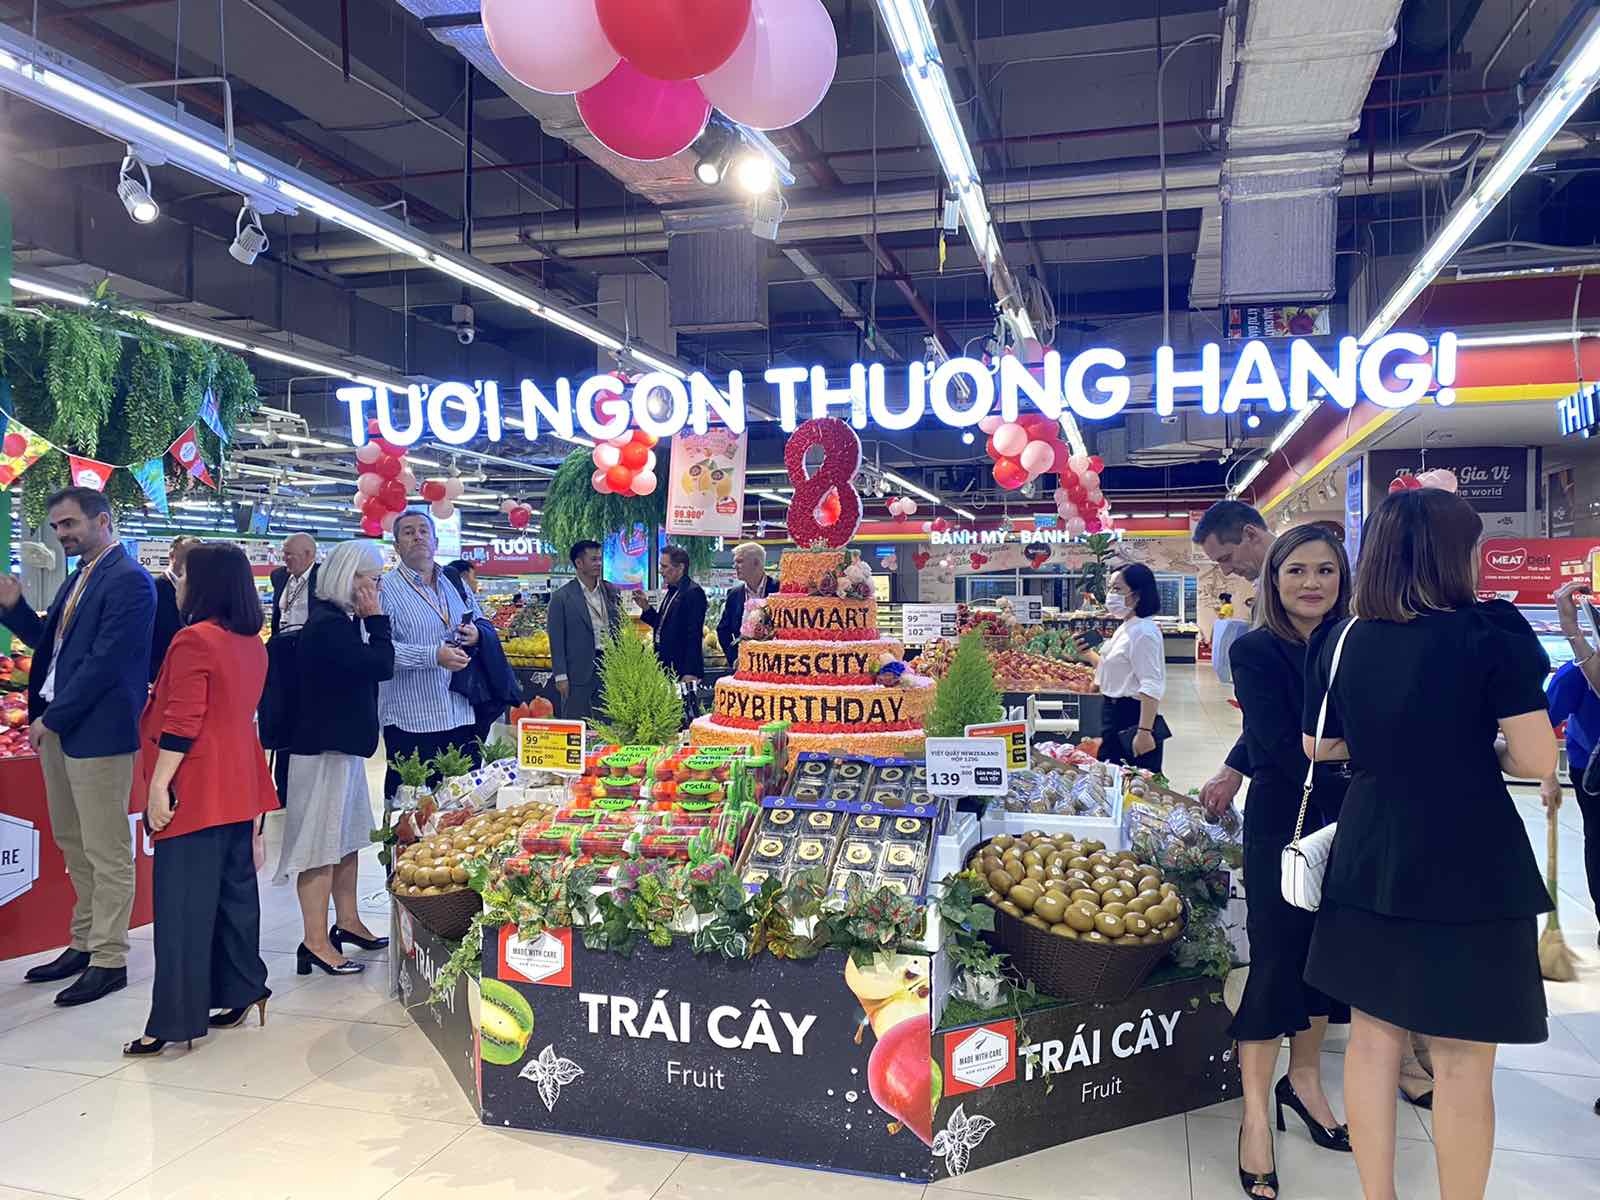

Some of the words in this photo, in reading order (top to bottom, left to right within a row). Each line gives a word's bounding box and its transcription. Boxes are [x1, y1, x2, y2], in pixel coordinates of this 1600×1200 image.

[335, 378, 502, 447] TƯƠI
[520, 368, 747, 442] NGON
[763, 346, 1132, 445] THƯỢNG
[1154, 330, 1458, 428] HẠNG!
[784, 416, 863, 549] 8
[1461, 466, 1488, 483] Gia
[1491, 465, 1511, 484] Vị
[1472, 487, 1502, 496] world
[930, 527, 977, 545] BÁNH
[1021, 527, 1070, 545] BÁNH
[140, 556, 151, 565] 50
[1491, 555, 1523, 565] MEAT
[1527, 553, 1551, 565] Deli
[907, 615, 919, 623] 99
[908, 628, 924, 636] 102
[526, 735, 538, 745] 99
[526, 755, 544, 765] 106
[930, 773, 960, 786] 139
[1, 848, 20, 866] RE
[512, 947, 528, 957] MADE
[528, 949, 541, 957] WITH
[543, 950, 557, 959] CARE
[578, 988, 691, 1044] TRÁI
[706, 998, 818, 1056] CÂY
[1018, 1023, 1101, 1082] TRÁI
[1111, 1008, 1182, 1059] CÂY
[959, 1054, 973, 1066] MADE
[974, 1051, 988, 1062] WITH
[989, 1047, 1002, 1059] CARE
[666, 1060, 726, 1090] Fruit
[1081, 1075, 1122, 1103] Fruit
